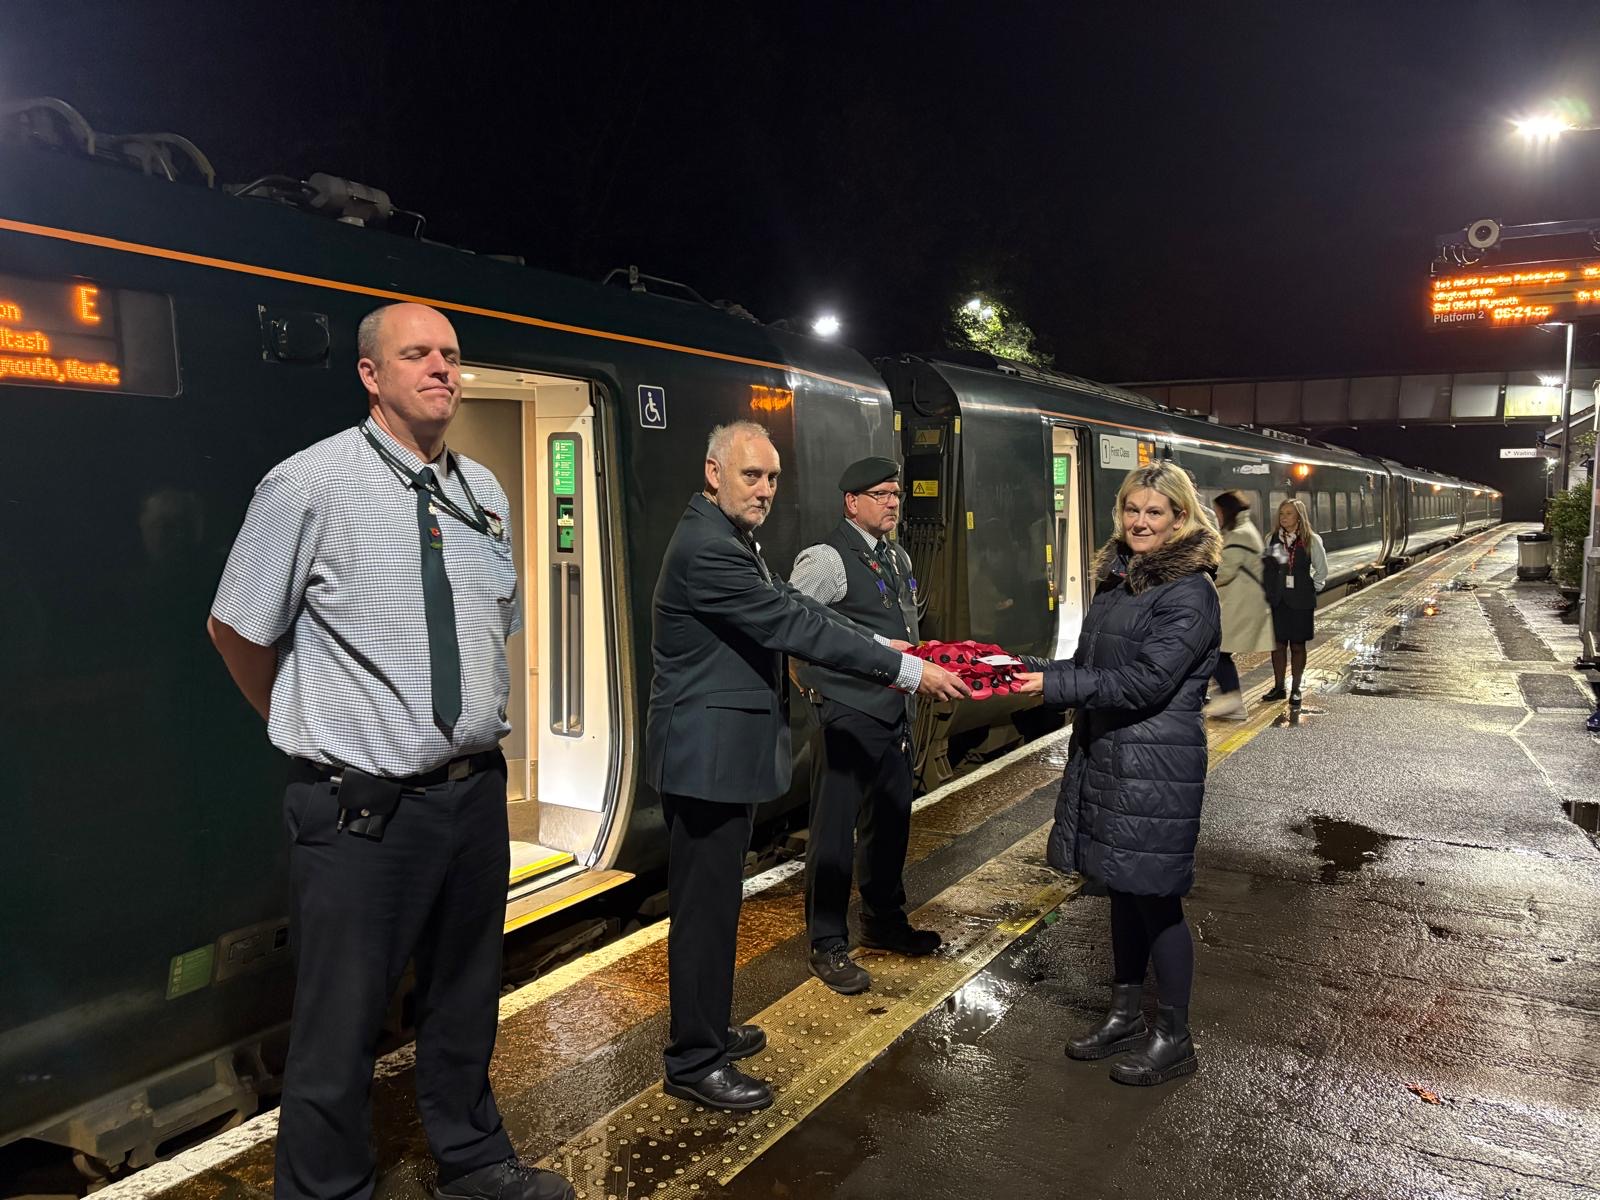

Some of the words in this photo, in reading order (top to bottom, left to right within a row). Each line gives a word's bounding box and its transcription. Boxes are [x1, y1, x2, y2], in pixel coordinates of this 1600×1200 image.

[79, 285, 101, 322] E
[1479, 295, 1519, 309] Plymouth
[1434, 312, 1476, 324] Platform
[1478, 310, 1485, 319] 2
